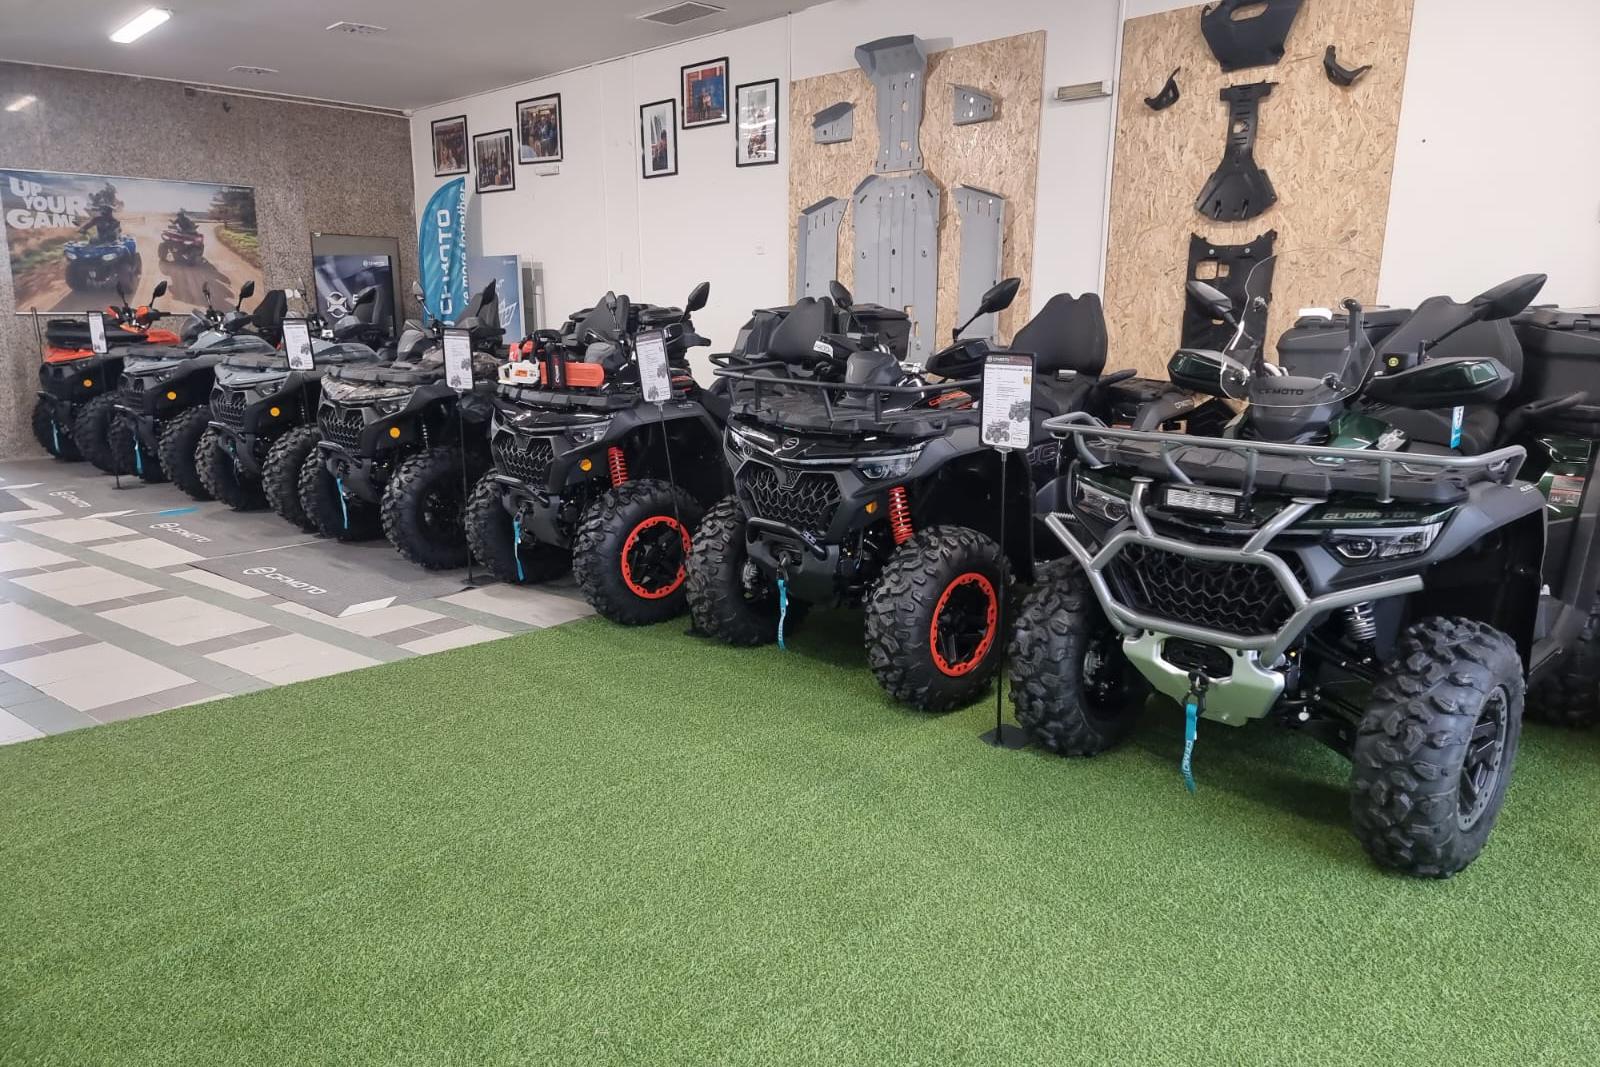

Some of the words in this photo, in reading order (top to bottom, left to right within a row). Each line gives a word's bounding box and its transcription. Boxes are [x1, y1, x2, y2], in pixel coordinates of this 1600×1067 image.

[9, 176, 42, 197] UP
[23, 195, 90, 218] YOUR
[6, 209, 81, 230] GAME
[265, 573, 327, 595] CFMOTO
